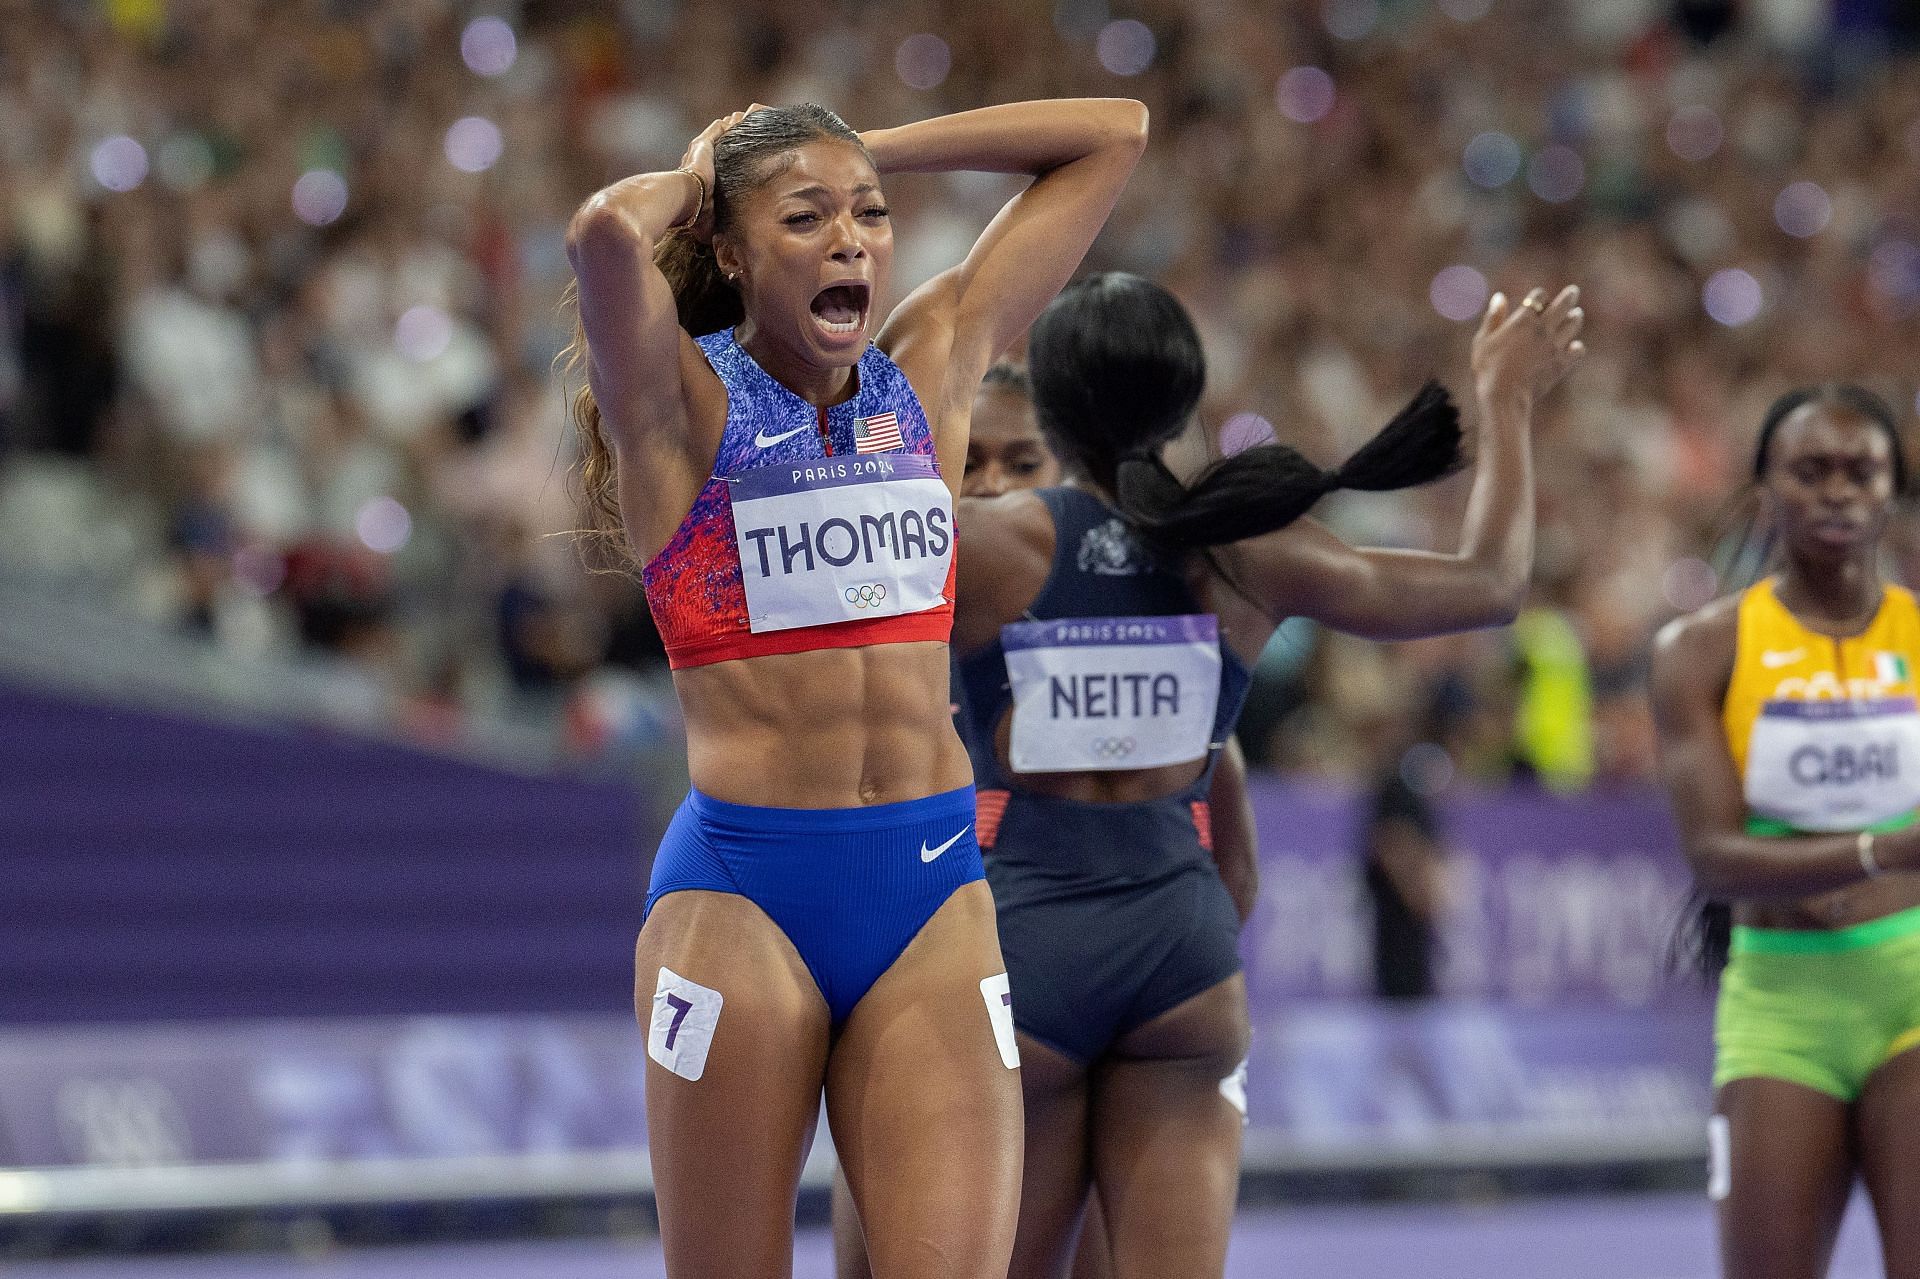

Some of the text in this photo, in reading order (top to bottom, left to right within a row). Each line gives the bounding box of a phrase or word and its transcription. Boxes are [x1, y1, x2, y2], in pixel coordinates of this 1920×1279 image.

[853, 462, 895, 477] 2024
[745, 507, 949, 577] THOMAS
[1056, 624, 1168, 641] PARIS 2024
[1050, 673, 1180, 719] NEITA
[666, 992, 693, 1051] 7
